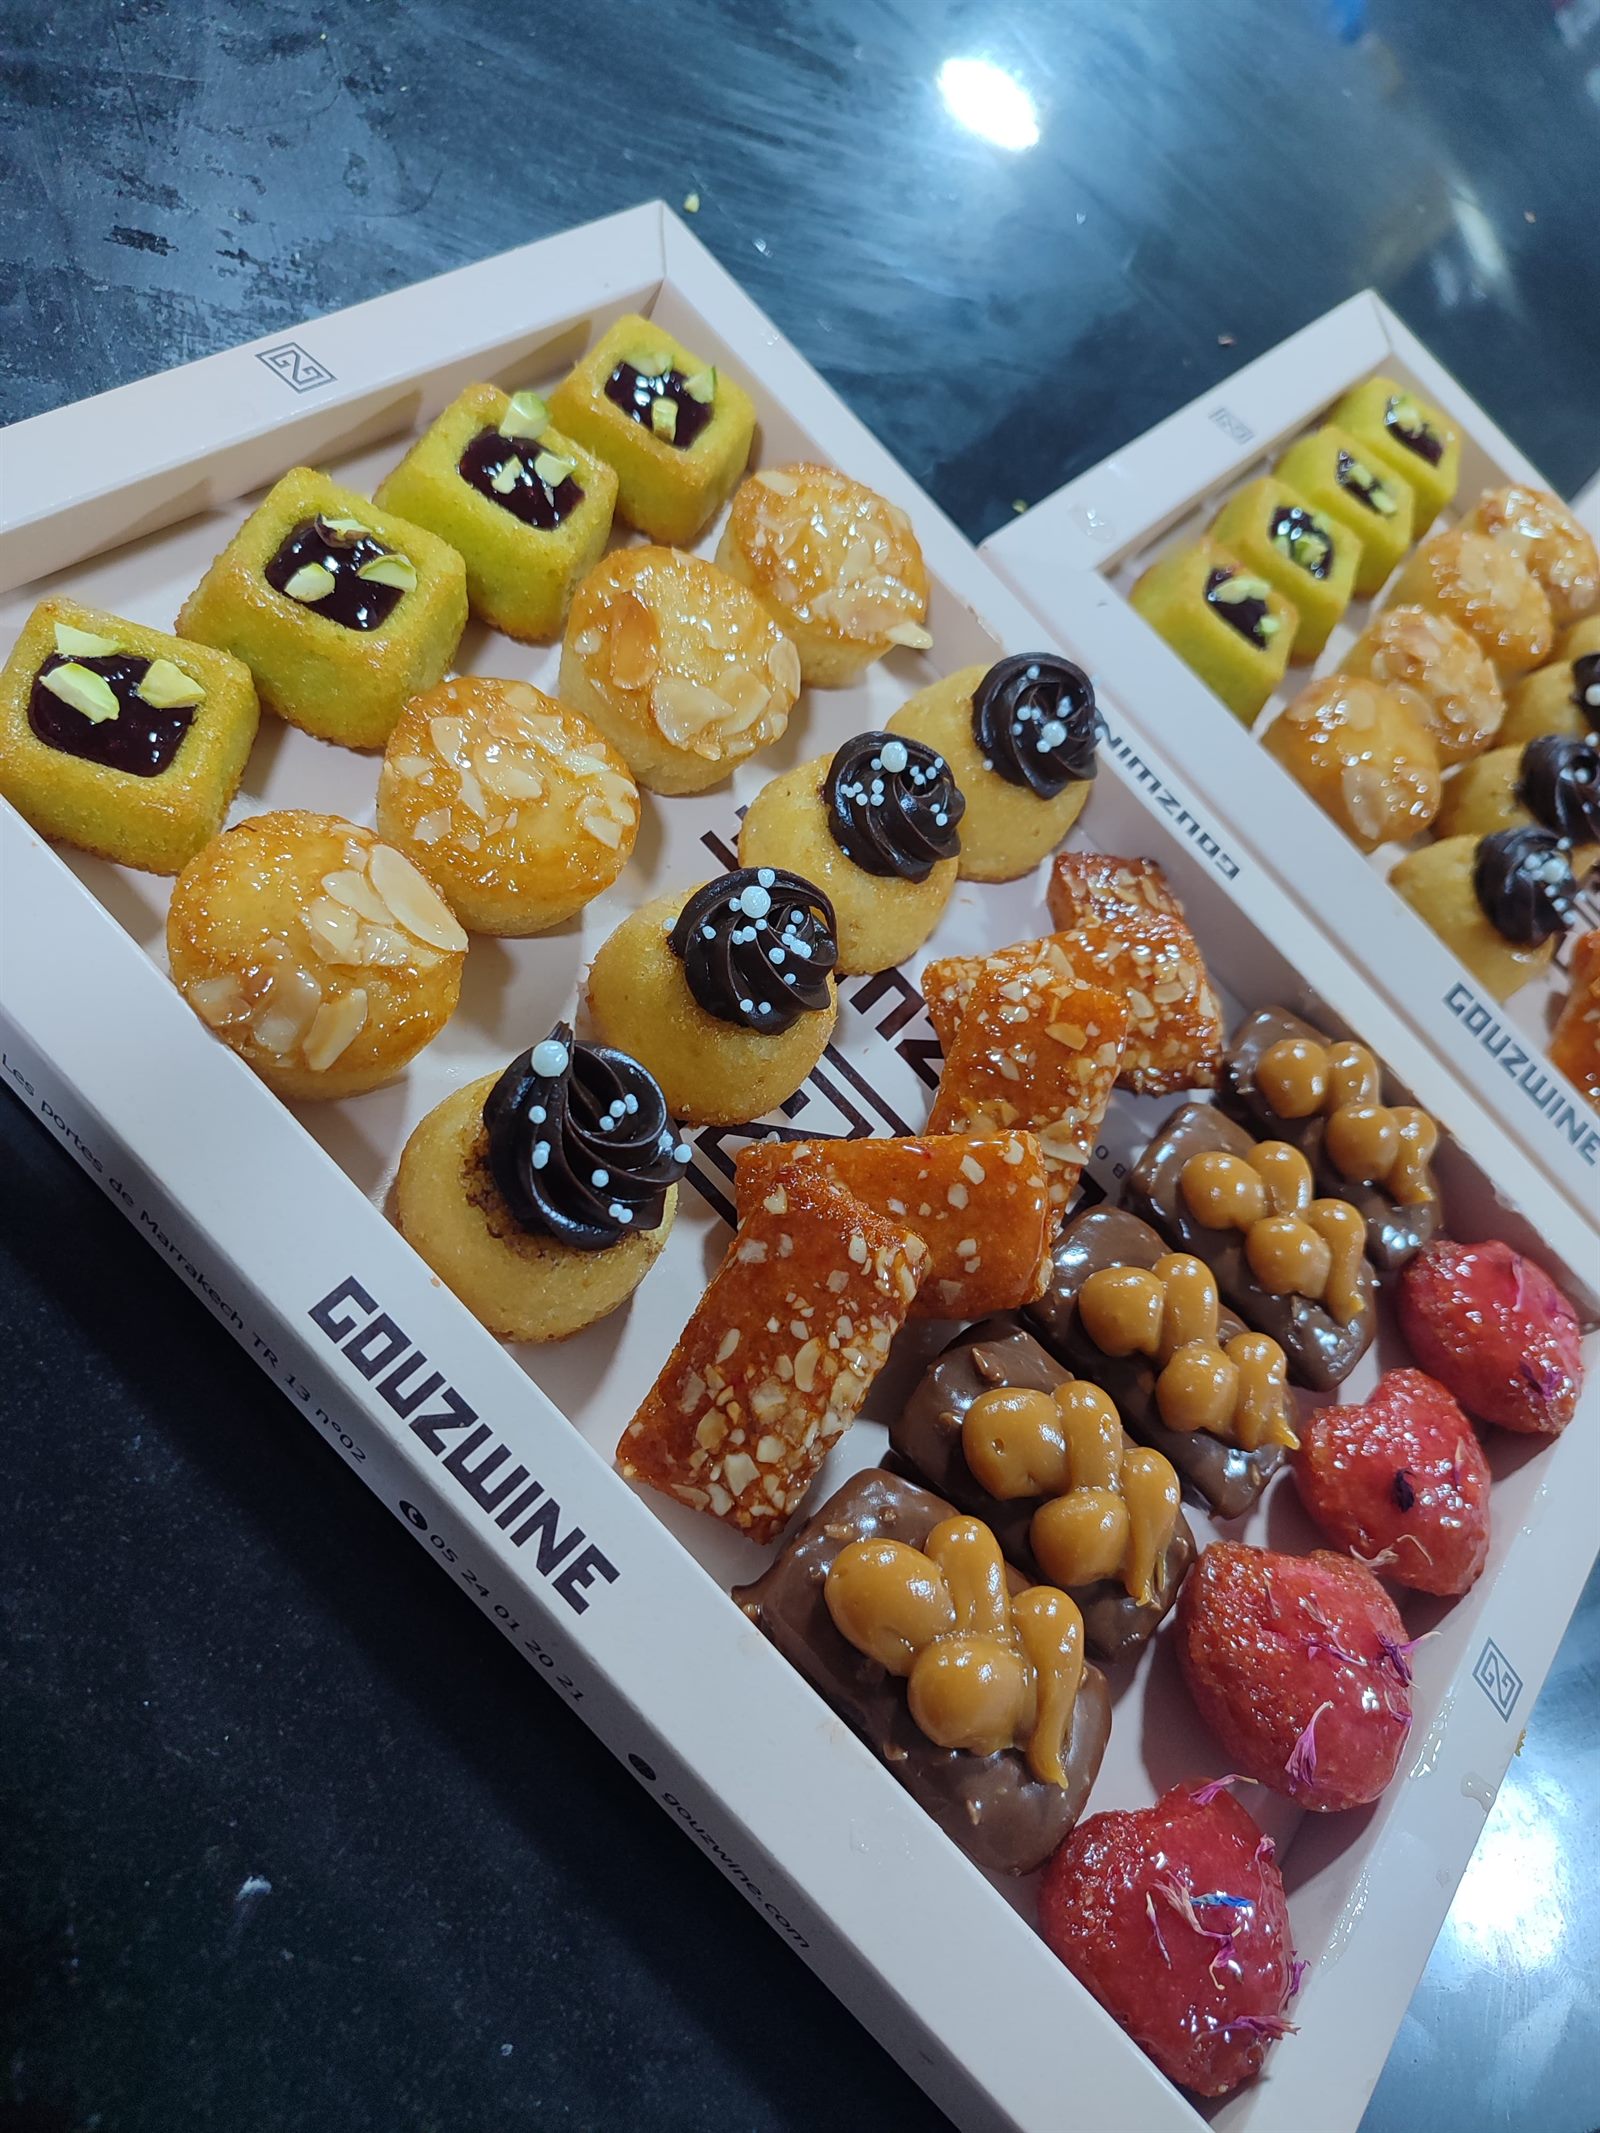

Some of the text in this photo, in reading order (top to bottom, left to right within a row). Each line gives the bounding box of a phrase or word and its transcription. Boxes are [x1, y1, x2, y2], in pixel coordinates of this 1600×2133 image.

[1095, 712, 1240, 880] GOUZWIN
[1442, 982, 1600, 1167] GOUZWINE
[2, 1053, 35, 1096] Les
[41, 1100, 103, 1173] portes
[109, 1177, 134, 1207] de
[140, 1210, 244, 1329] Marrakech
[252, 1332, 279, 1368] TR
[284, 1374, 311, 1402] 13
[308, 1275, 620, 1615] GOUZWINE
[430, 1534, 584, 1702] 05 24 01 20 21
[661, 1791, 810, 1949] gouzwine.com
